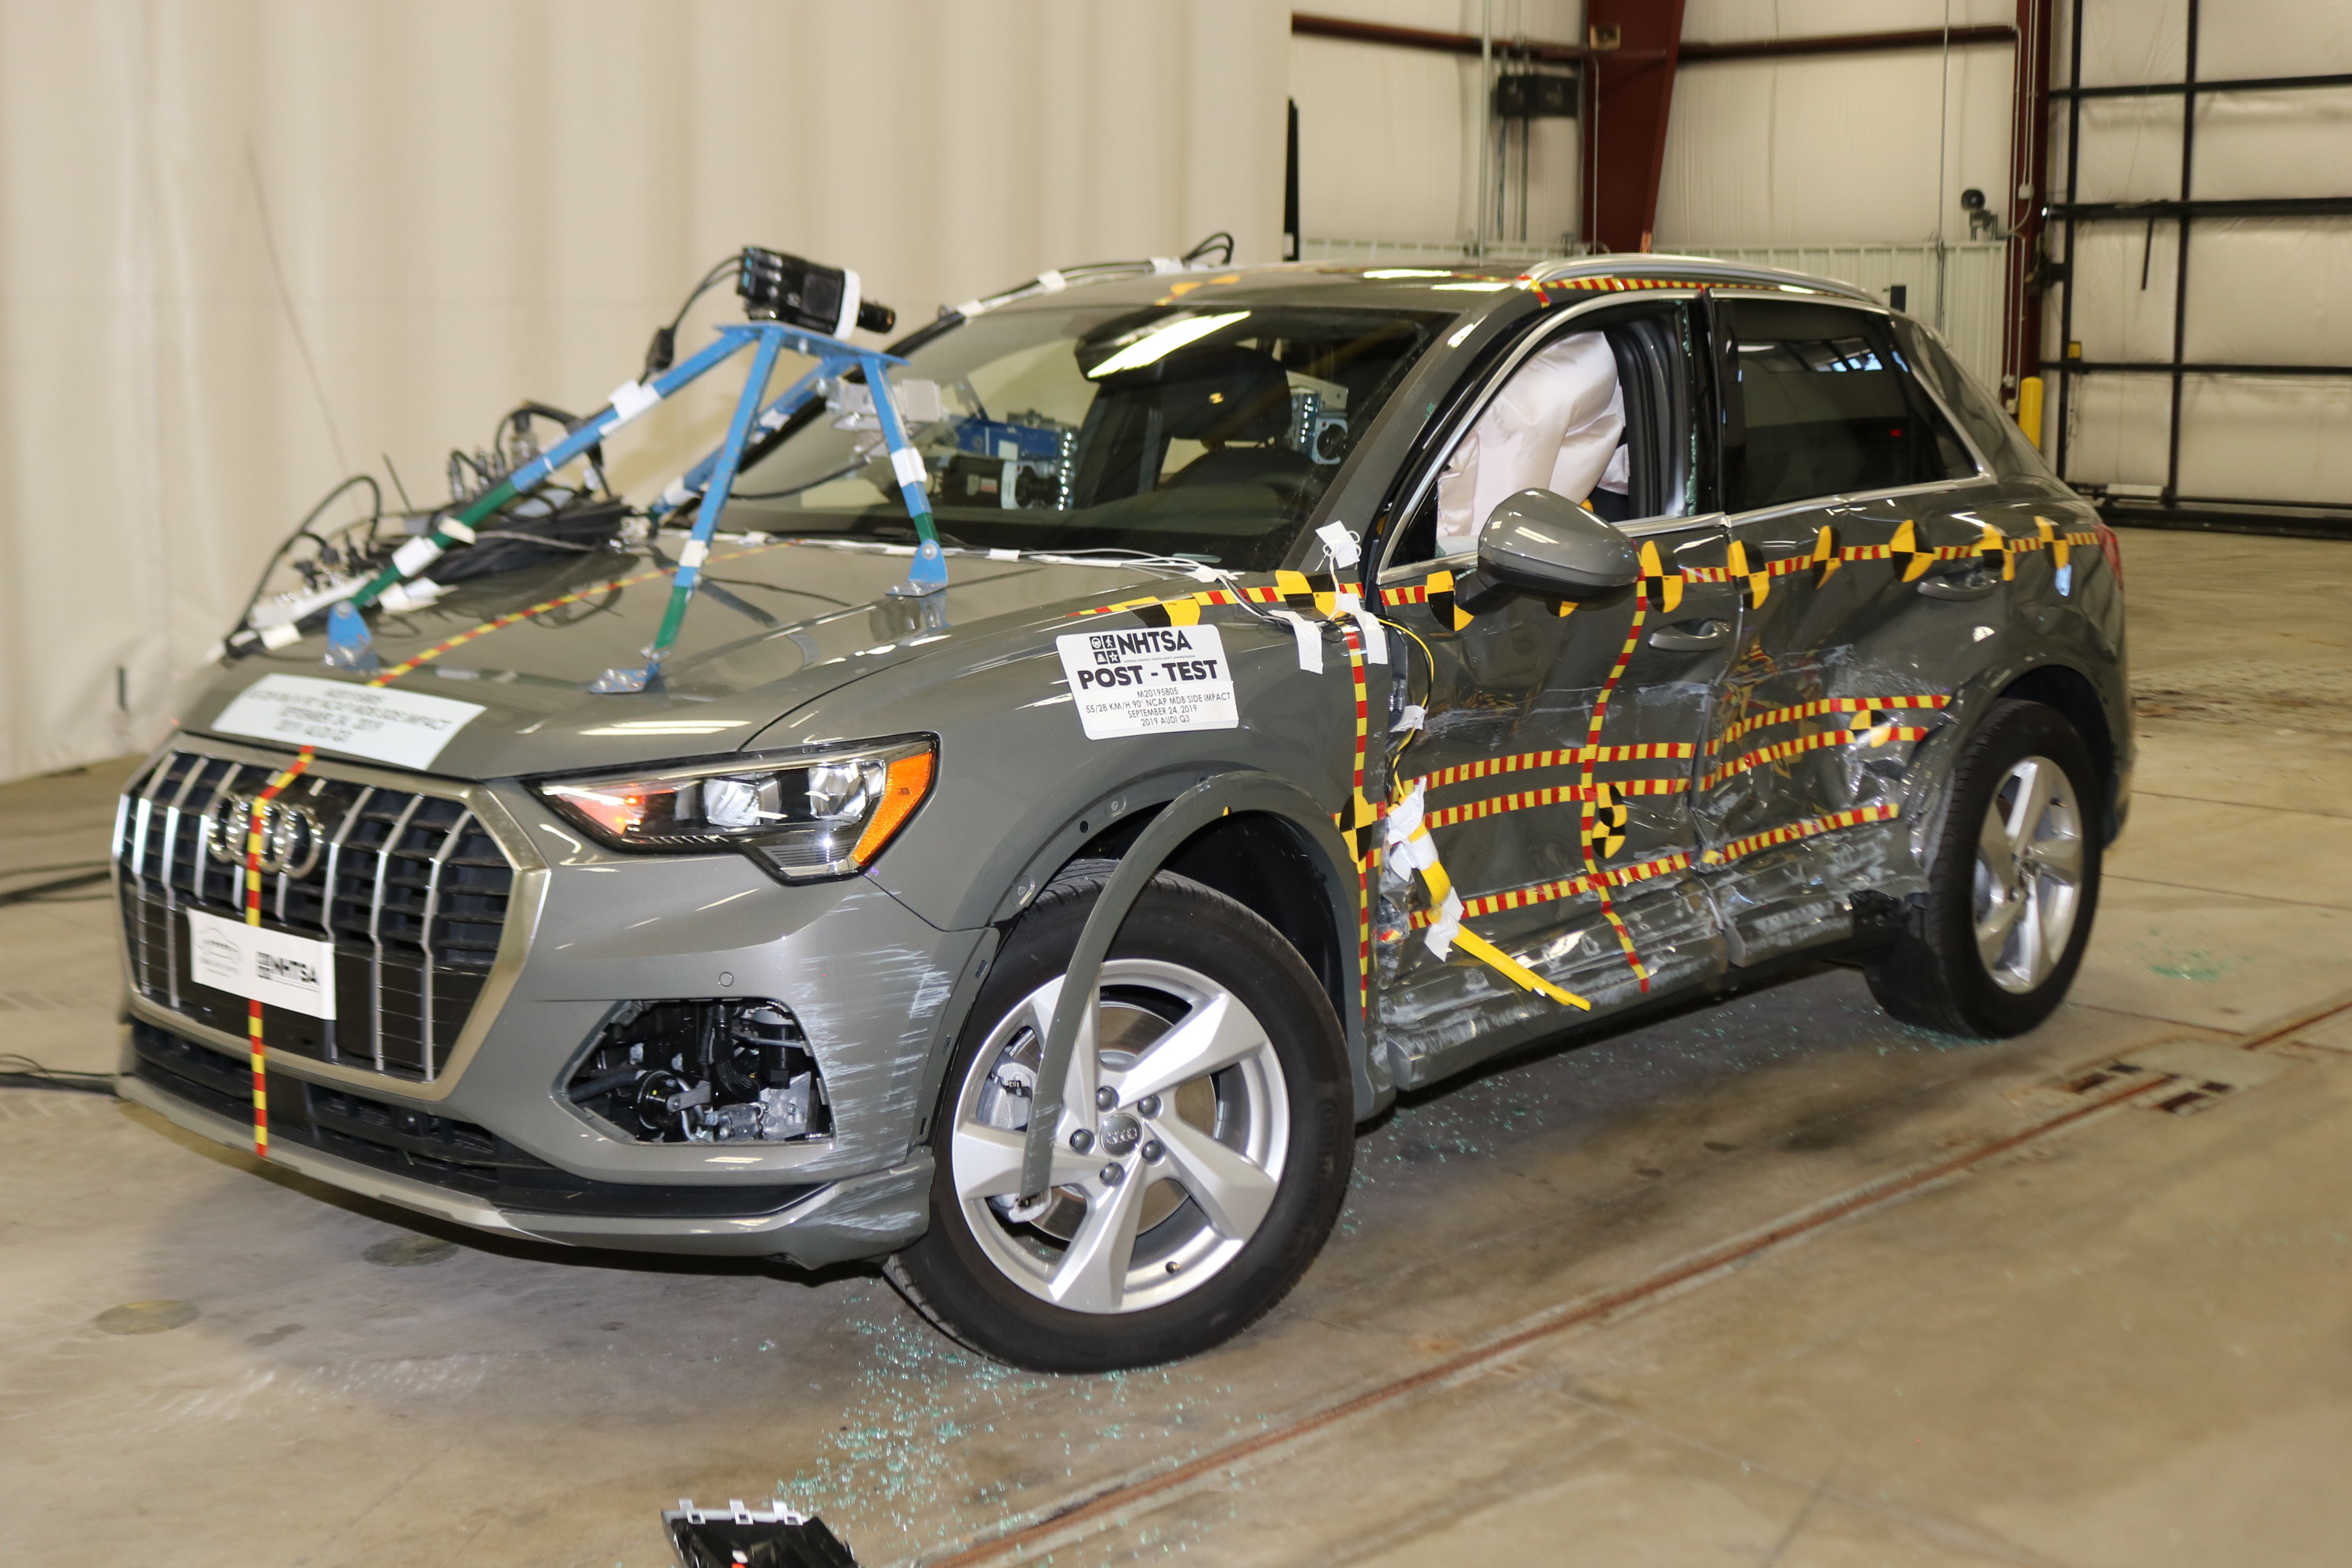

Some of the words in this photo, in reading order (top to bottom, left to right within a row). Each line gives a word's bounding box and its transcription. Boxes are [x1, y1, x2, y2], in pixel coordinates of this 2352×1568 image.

[1116, 629, 1193, 655] NHTSA
[1077, 665, 1144, 690] POST
[1161, 660, 1218, 682] TEST
[1136, 687, 1178, 698] M20195805
[1086, 703, 1108, 714] 55/28
[1109, 701, 1131, 710] KM/H
[1145, 698, 1167, 707] NCAP
[1169, 695, 1186, 705] MDB
[1187, 694, 1203, 703] SIDE
[1204, 692, 1231, 702] IMPACT
[1127, 707, 1167, 718] SEPTEMBER
[1168, 706, 1180, 715] 24,
[1181, 704, 1197, 714] 2019
[1140, 717, 1158, 726] 2019
[1160, 715, 1178, 725] AUDI
[1179, 714, 1190, 723] Q3
